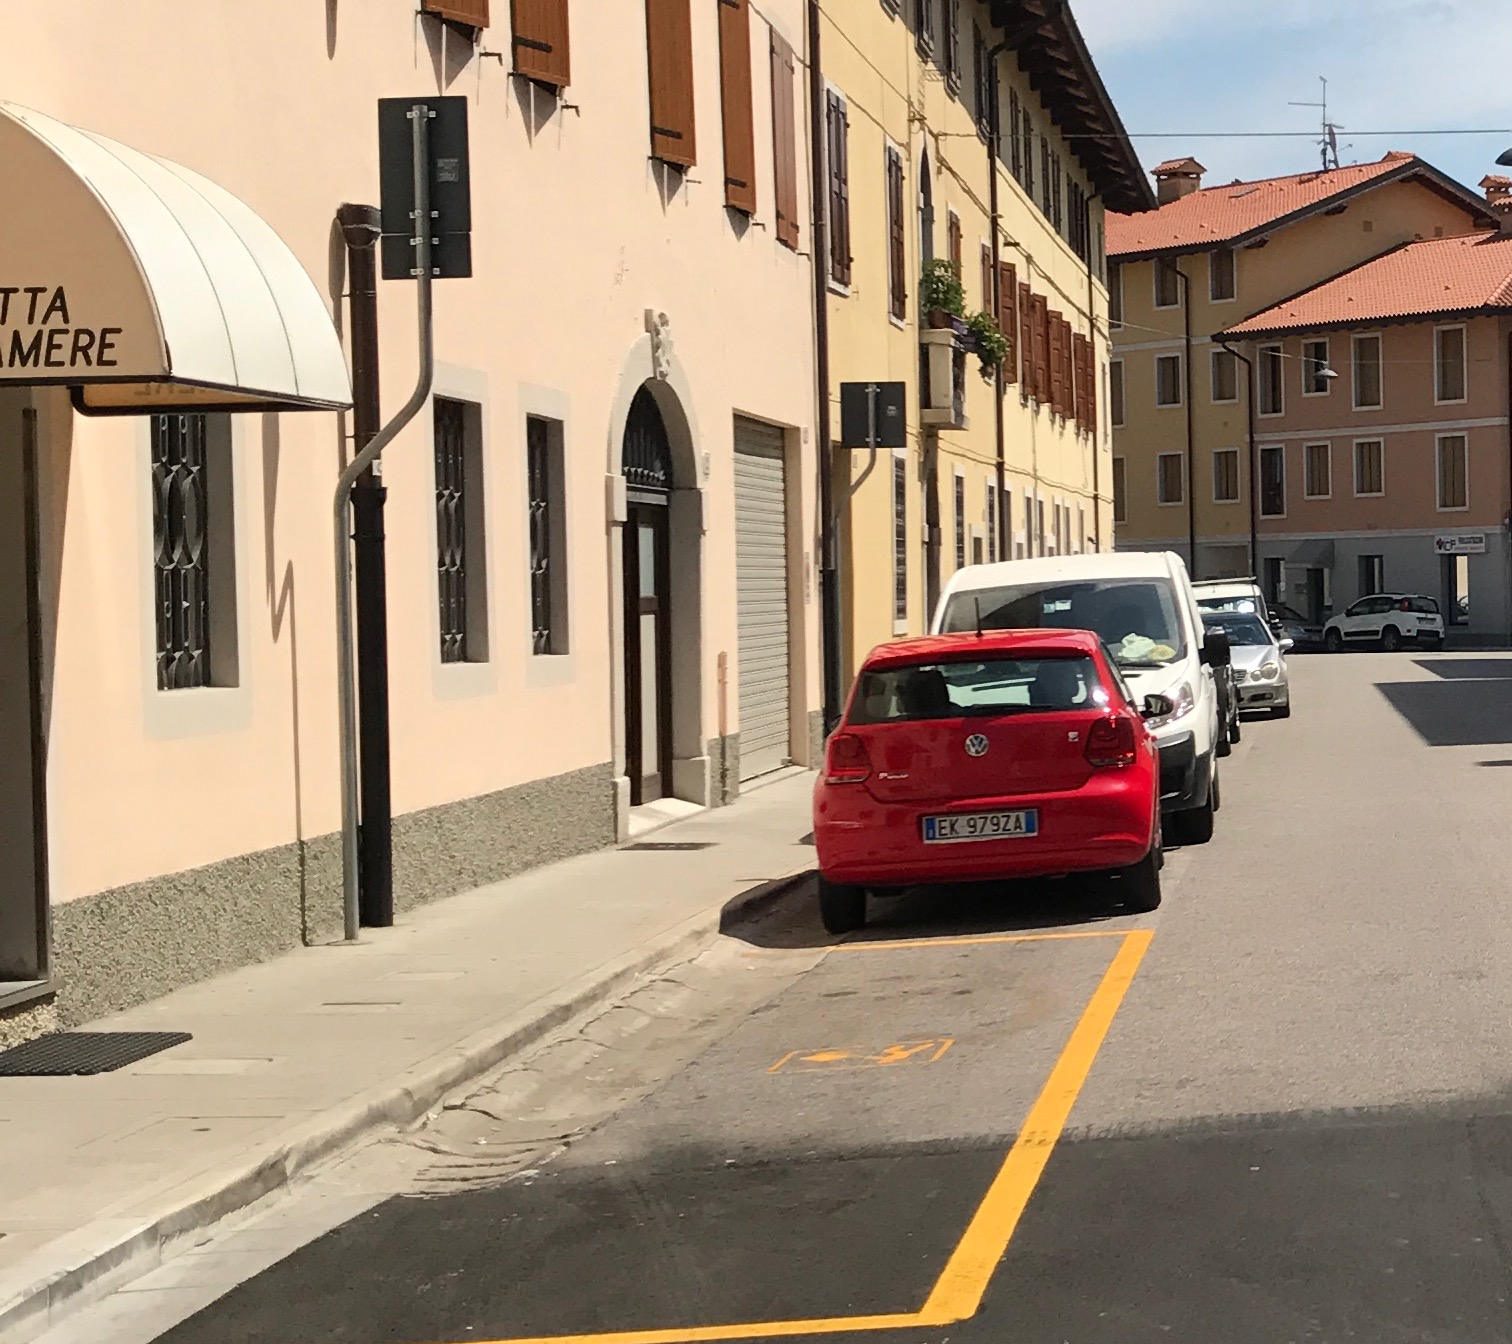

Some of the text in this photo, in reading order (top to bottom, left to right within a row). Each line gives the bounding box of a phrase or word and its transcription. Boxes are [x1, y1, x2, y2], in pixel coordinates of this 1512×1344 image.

[0, 328, 122, 367] MERE
[938, 814, 1023, 836] EK 979ZA
